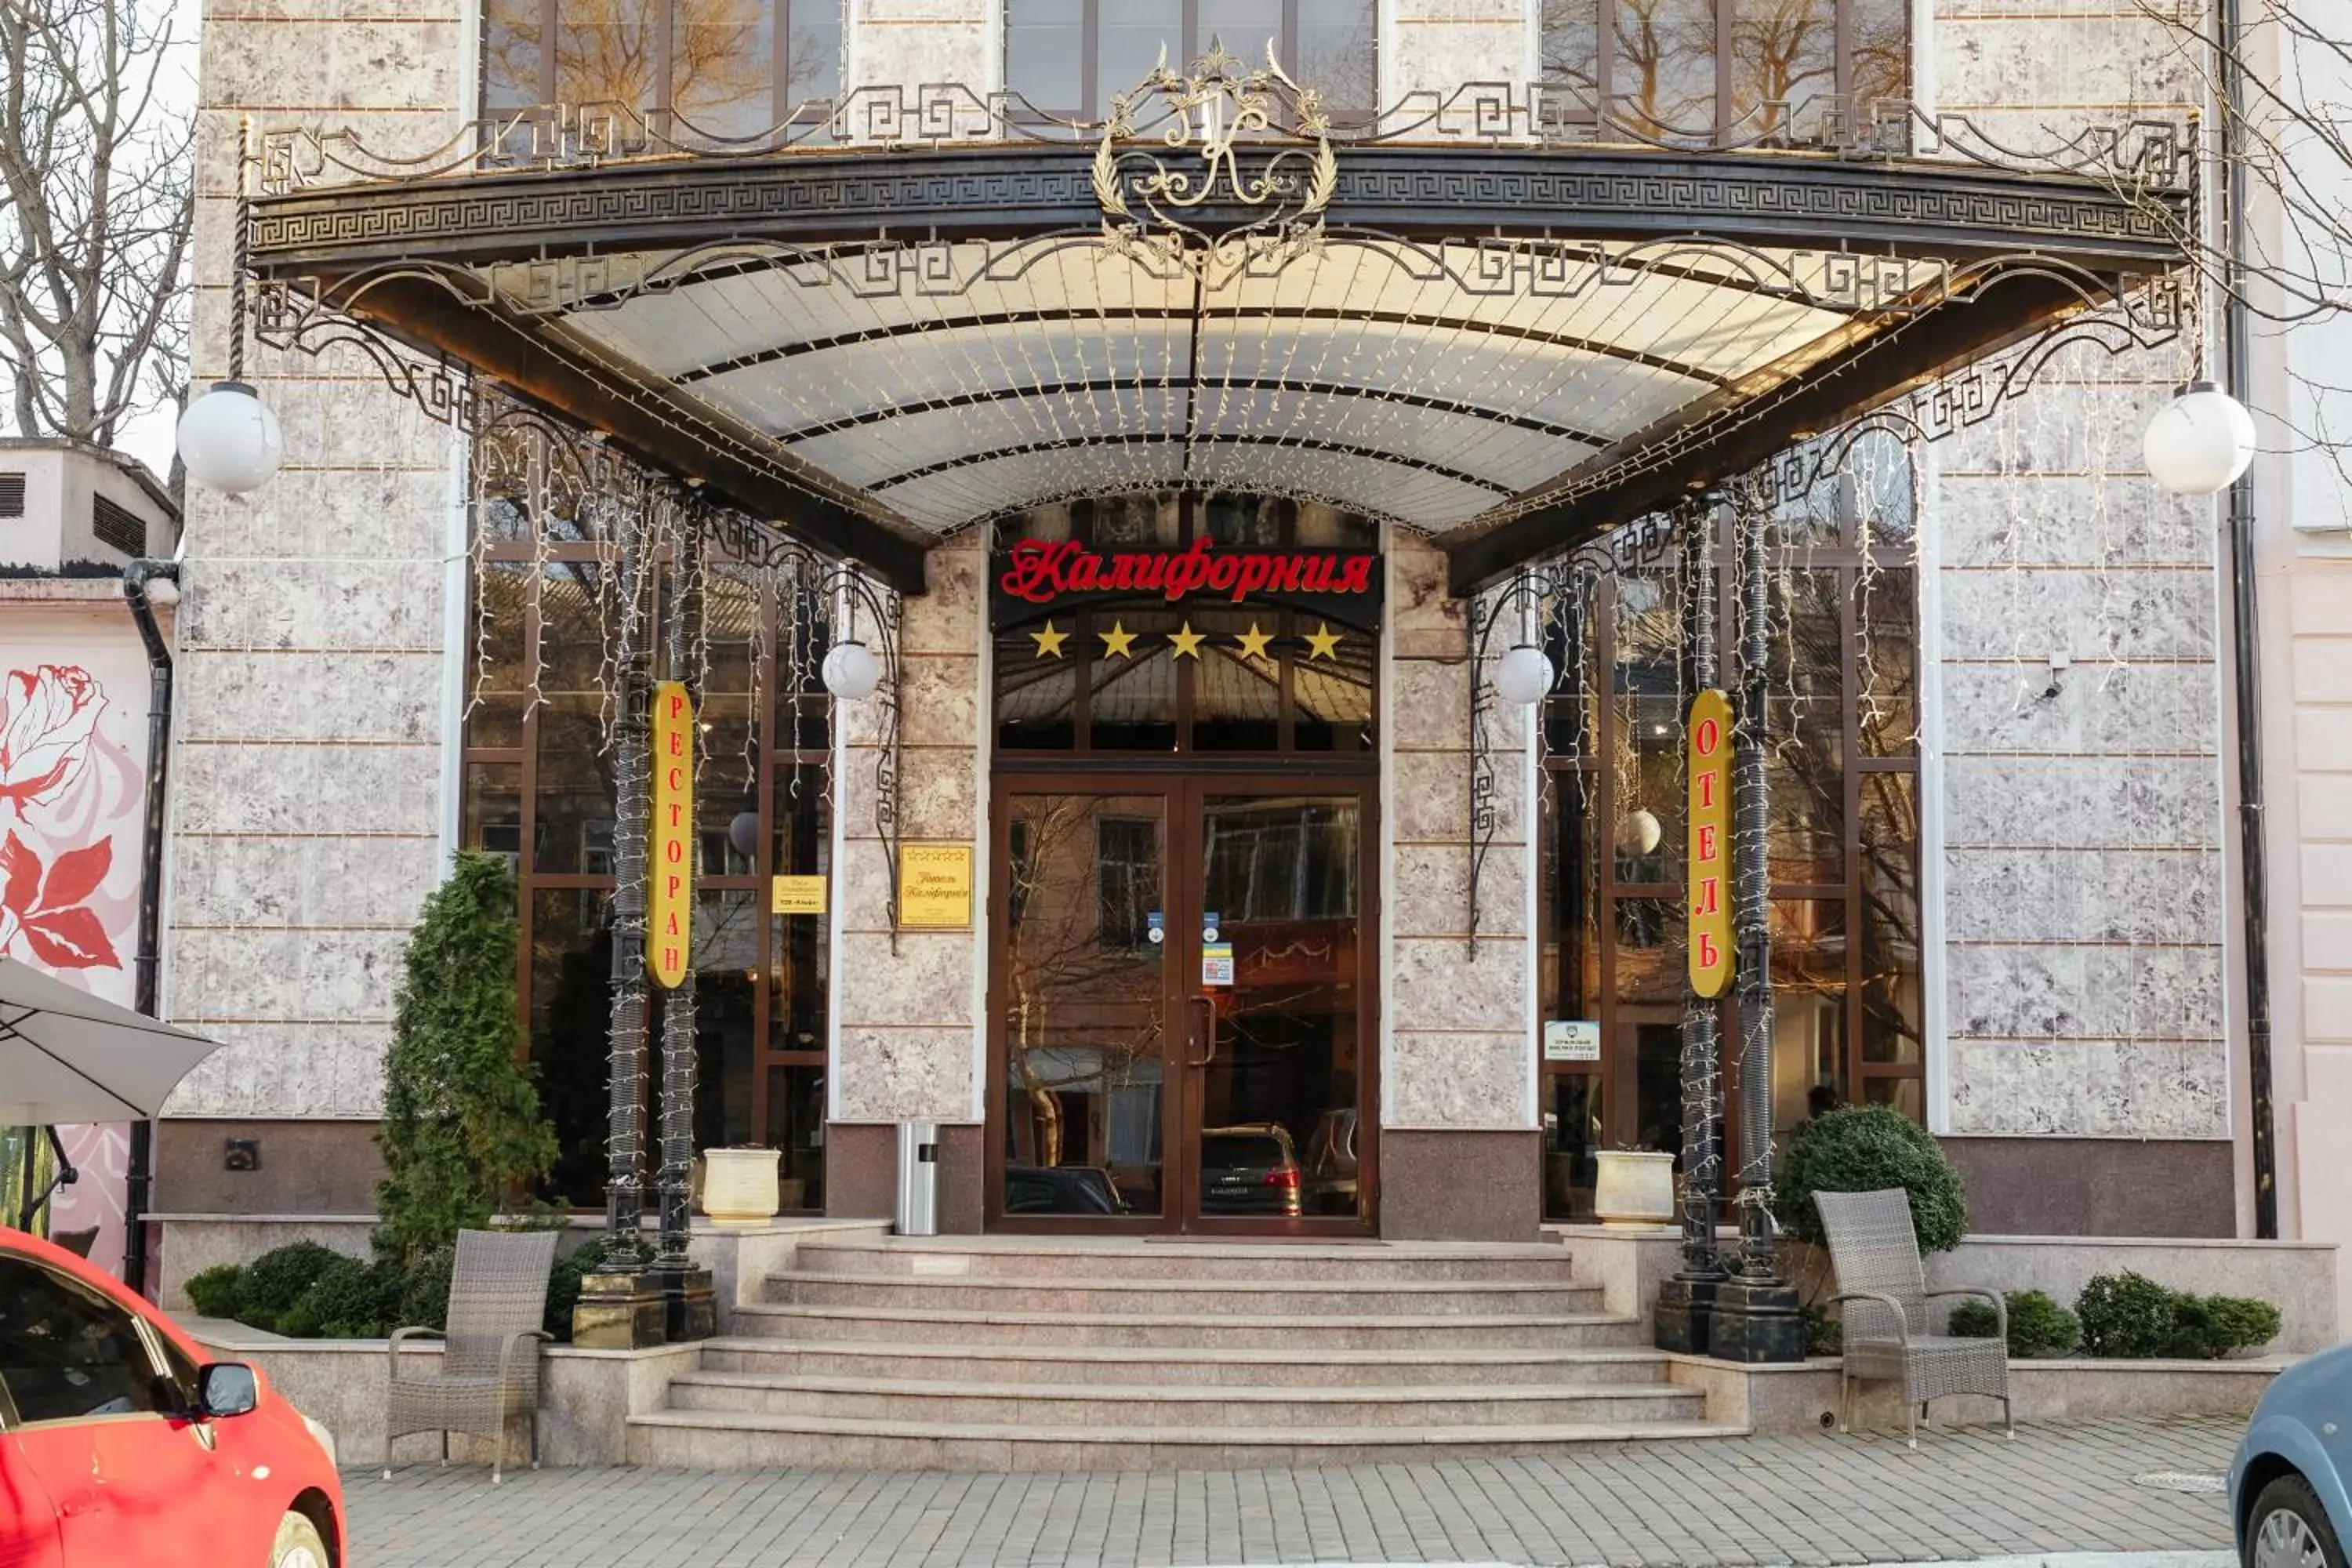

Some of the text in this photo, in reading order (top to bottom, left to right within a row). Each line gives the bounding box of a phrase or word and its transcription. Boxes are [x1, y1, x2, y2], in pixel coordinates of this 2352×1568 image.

[1001, 535, 1372, 603] Калифорния
[665, 695, 683, 971] РЕСТОРАН
[1695, 719, 1719, 967] ОТЕЛЬ
